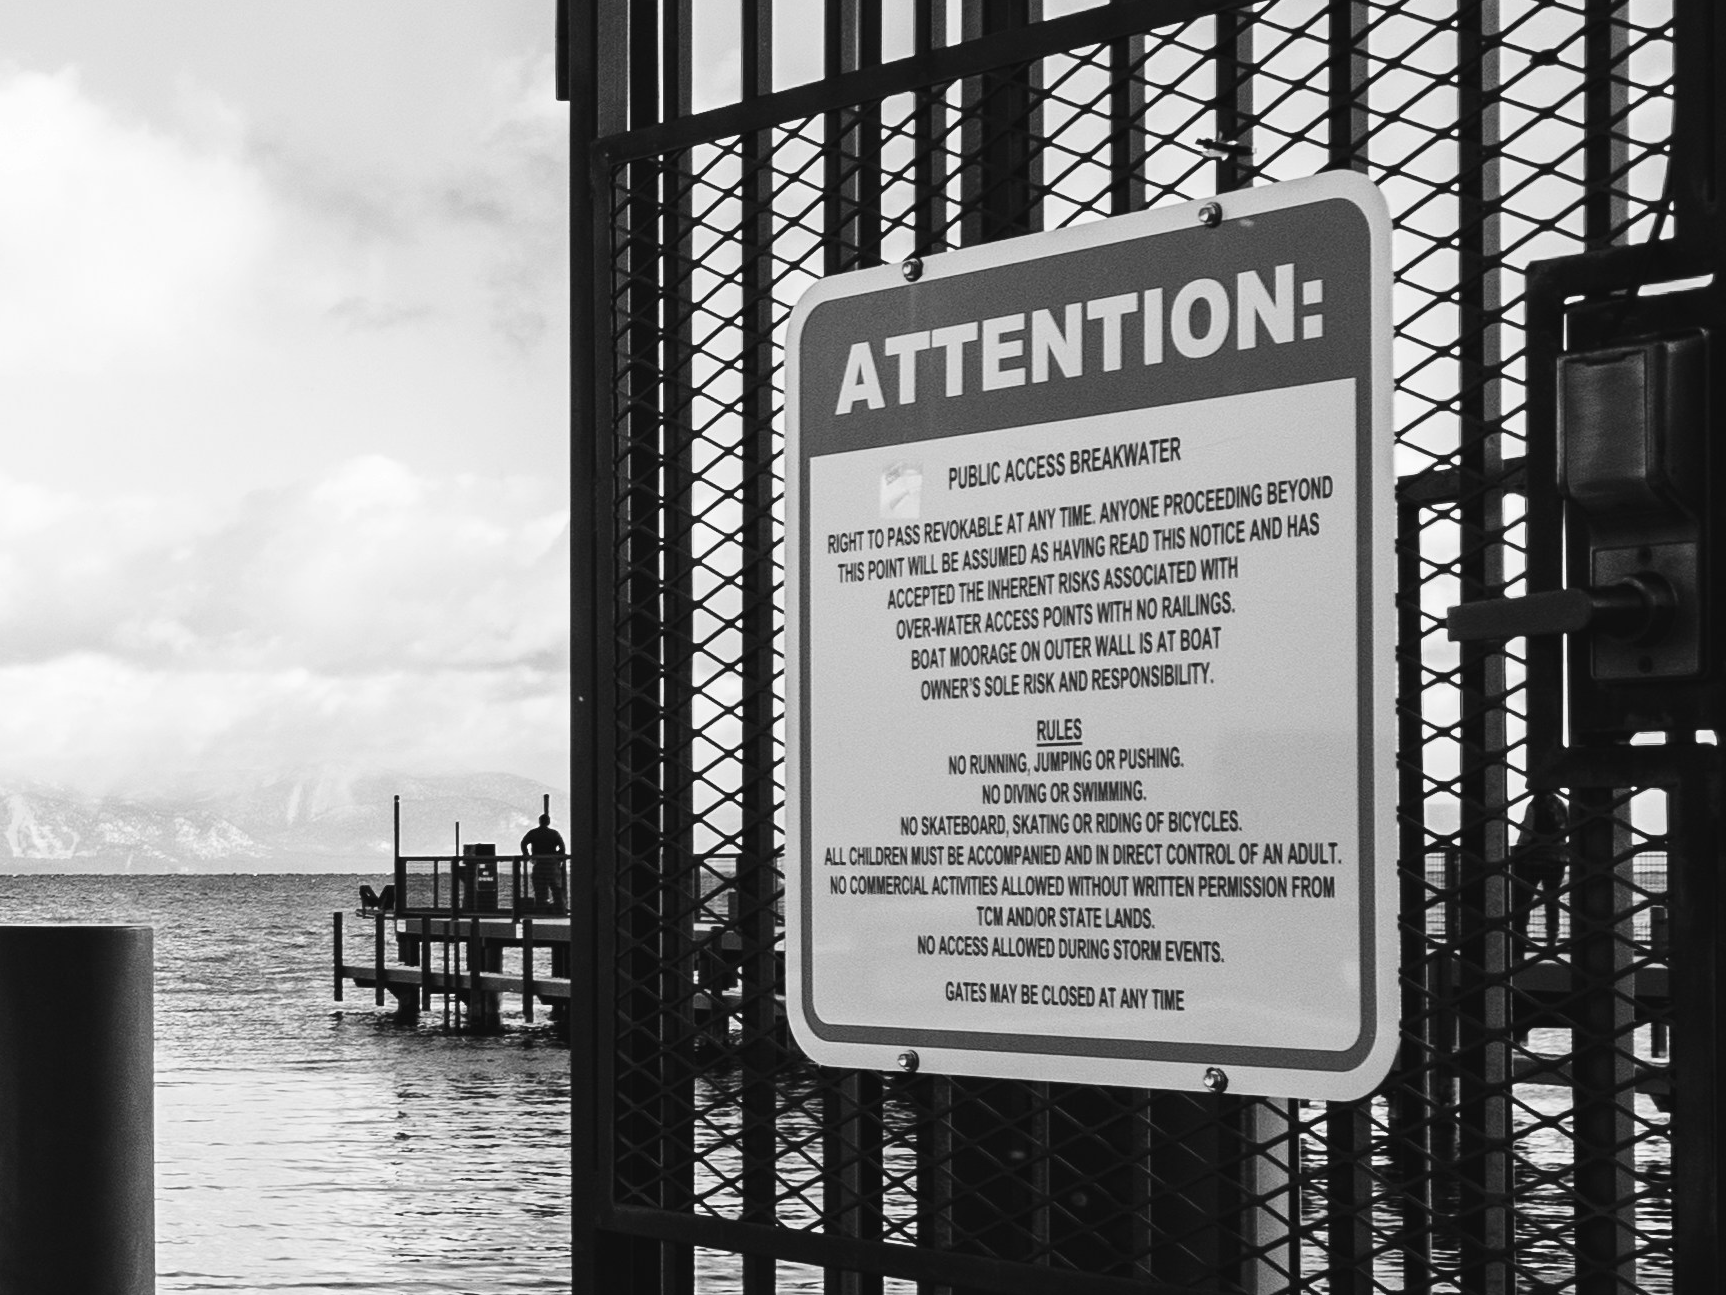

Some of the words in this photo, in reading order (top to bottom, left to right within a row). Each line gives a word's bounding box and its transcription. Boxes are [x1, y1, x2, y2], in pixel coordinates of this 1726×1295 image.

[835, 264, 1323, 416] ATTENTION:
[948, 459, 1001, 491] PUBLIC
[1003, 451, 1066, 484] ACCESS
[1069, 435, 1181, 475] BREAKWATER
[827, 529, 865, 555] RIGHT
[866, 526, 884, 550] TO
[887, 522, 920, 548] PASS
[923, 512, 1003, 544] REVOKABLE
[1006, 510, 1024, 535] AT
[1027, 506, 1056, 533] ANY
[1058, 502, 1096, 529] TIME.
[1099, 494, 1160, 525] ANYONE
[1163, 482, 1262, 518] PROCEEDING
[1266, 474, 1333, 506] BEYOND
[837, 560, 865, 584] THIS
[867, 555, 905, 581] POINT
[907, 552, 938, 577] WILL
[941, 549, 959, 574] BE
[961, 542, 1027, 572] ASSUMED
[1029, 540, 1049, 565] AS
[1052, 534, 1105, 563] HAVING
[1109, 529, 1149, 557] READ
[1152, 525, 1186, 553] THIS
[1189, 519, 1245, 549] NOTICE
[1249, 515, 1283, 543] AND
[1286, 511, 1320, 539] HAS
[887, 582, 955, 610] ACCEPTED
[957, 579, 984, 604] THE
[987, 572, 1055, 601] INHERENT
[1058, 568, 1100, 595] RISKS
[1103, 559, 1197, 591] ASSOCIATED
[1200, 555, 1238, 582] WITH
[895, 611, 982, 640] OVER-WATER
[983, 606, 1039, 633] ACCESS
[1042, 602, 1093, 629] POINTS
[1096, 598, 1132, 624] WITH
[1136, 596, 1158, 621] NO
[1161, 589, 1235, 619] RAILINGS.
[911, 646, 946, 670] BOAT
[949, 640, 1017, 668] MOORAGE
[1020, 639, 1040, 663] ON
[1043, 635, 1092, 661] OUTER
[1094, 632, 1136, 658] WALL
[1139, 630, 1153, 655] IS
[1155, 628, 1177, 654] AT
[1179, 625, 1222, 652] BOAT
[920, 675, 981, 701] OWNER'S
[983, 673, 1020, 697] SOLE
[1023, 671, 1055, 695] RISK
[1058, 668, 1088, 693] AND
[1091, 660, 1214, 691] RESPONSIBILITY.
[1036, 717, 1082, 742] RULES
[948, 754, 966, 775] NO
[969, 751, 1030, 778] RUNNING,
[1033, 749, 1092, 773] JUMPING
[1095, 748, 1116, 771] OR
[1118, 745, 1184, 770] PUSHING.
[981, 783, 1001, 805] NO
[1003, 782, 1047, 804] DIVING
[1049, 781, 1070, 803] OR
[1072, 779, 1147, 803] SWIMMING.
[900, 815, 918, 836] NO
[921, 813, 1009, 840] SKATEBOARD,
[1012, 812, 1069, 835] SKATING
[1071, 812, 1093, 834] OR
[1095, 811, 1142, 834] RIDING
[1144, 810, 1164, 833] OF
[1167, 809, 1242, 833] BICYCLES.
[823, 845, 846, 866] ALL
[848, 845, 908, 866] CHILDREN
[910, 844, 945, 866] MUST
[947, 844, 964, 866] BE
[966, 843, 1061, 866] ACCOMPANIED
[1064, 843, 1092, 865] AND
[1095, 843, 1109, 865] IN
[1112, 842, 1163, 865] DIRECT
[1165, 842, 1235, 865] CONTROL
[1238, 842, 1259, 865] OF
[1261, 841, 1283, 865] AN
[1286, 841, 1342, 865] ADULT.
[829, 875, 847, 895] NO
[849, 875, 929, 896] COMMERCIAL
[931, 875, 998, 896] ACTIVITIES
[1000, 875, 1065, 897] ALLOWED
[1067, 875, 1129, 897] WITHOUT
[1131, 875, 1194, 898] WRITTEN
[1198, 875, 1288, 898] PERMISSION
[1291, 875, 1335, 899] FROM
[975, 905, 1003, 927] TCM
[1005, 905, 1056, 928] AND/OR
[1058, 906, 1102, 929] STATE
[1104, 906, 1155, 930] LANDS.
[917, 934, 936, 955] NO
[938, 934, 988, 957] ACCESS
[991, 935, 1055, 959] ALLOWED
[1057, 937, 1110, 960] DURING
[1112, 938, 1162, 962] STORM
[1164, 939, 1225, 963] EVENTS.
[945, 980, 987, 1003] GATES
[989, 982, 1018, 1004] MAY
[1020, 983, 1038, 1005] BE
[1041, 984, 1095, 1008] CLOSED
[1098, 986, 1117, 1009] AT
[1119, 986, 1148, 1010] ANY
[1150, 988, 1185, 1011] TIME
